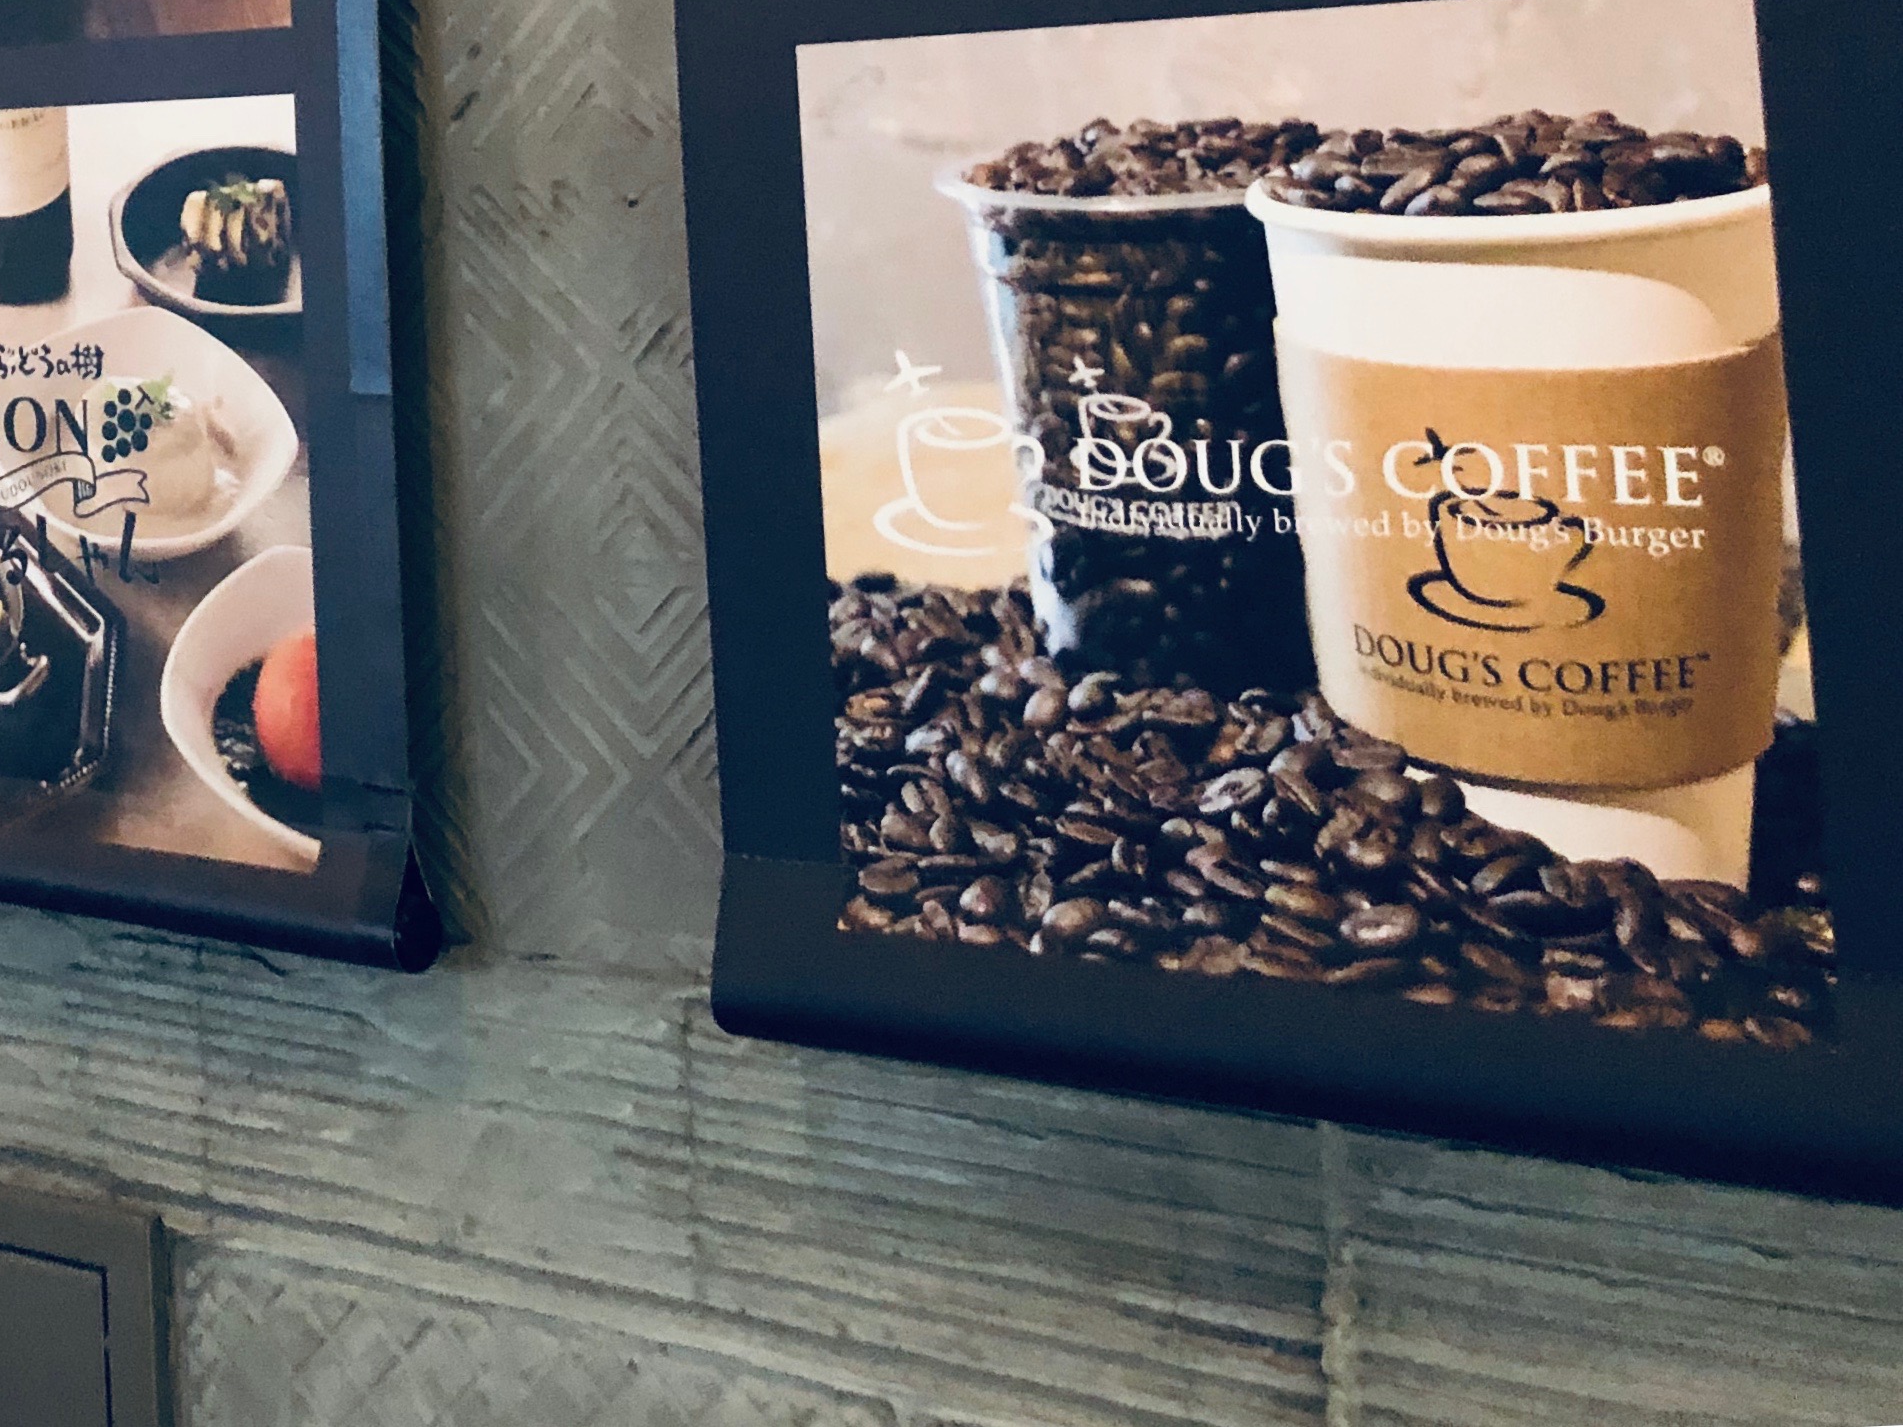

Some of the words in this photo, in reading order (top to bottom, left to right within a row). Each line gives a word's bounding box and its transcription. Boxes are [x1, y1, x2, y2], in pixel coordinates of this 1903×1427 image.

[1074, 437, 1356, 496] DOUG'S
[1400, 510, 1440, 548] by
[1457, 515, 1571, 552] Doug's
[1583, 517, 1706, 558] Burger
[1353, 623, 1502, 688] DOUG'S
